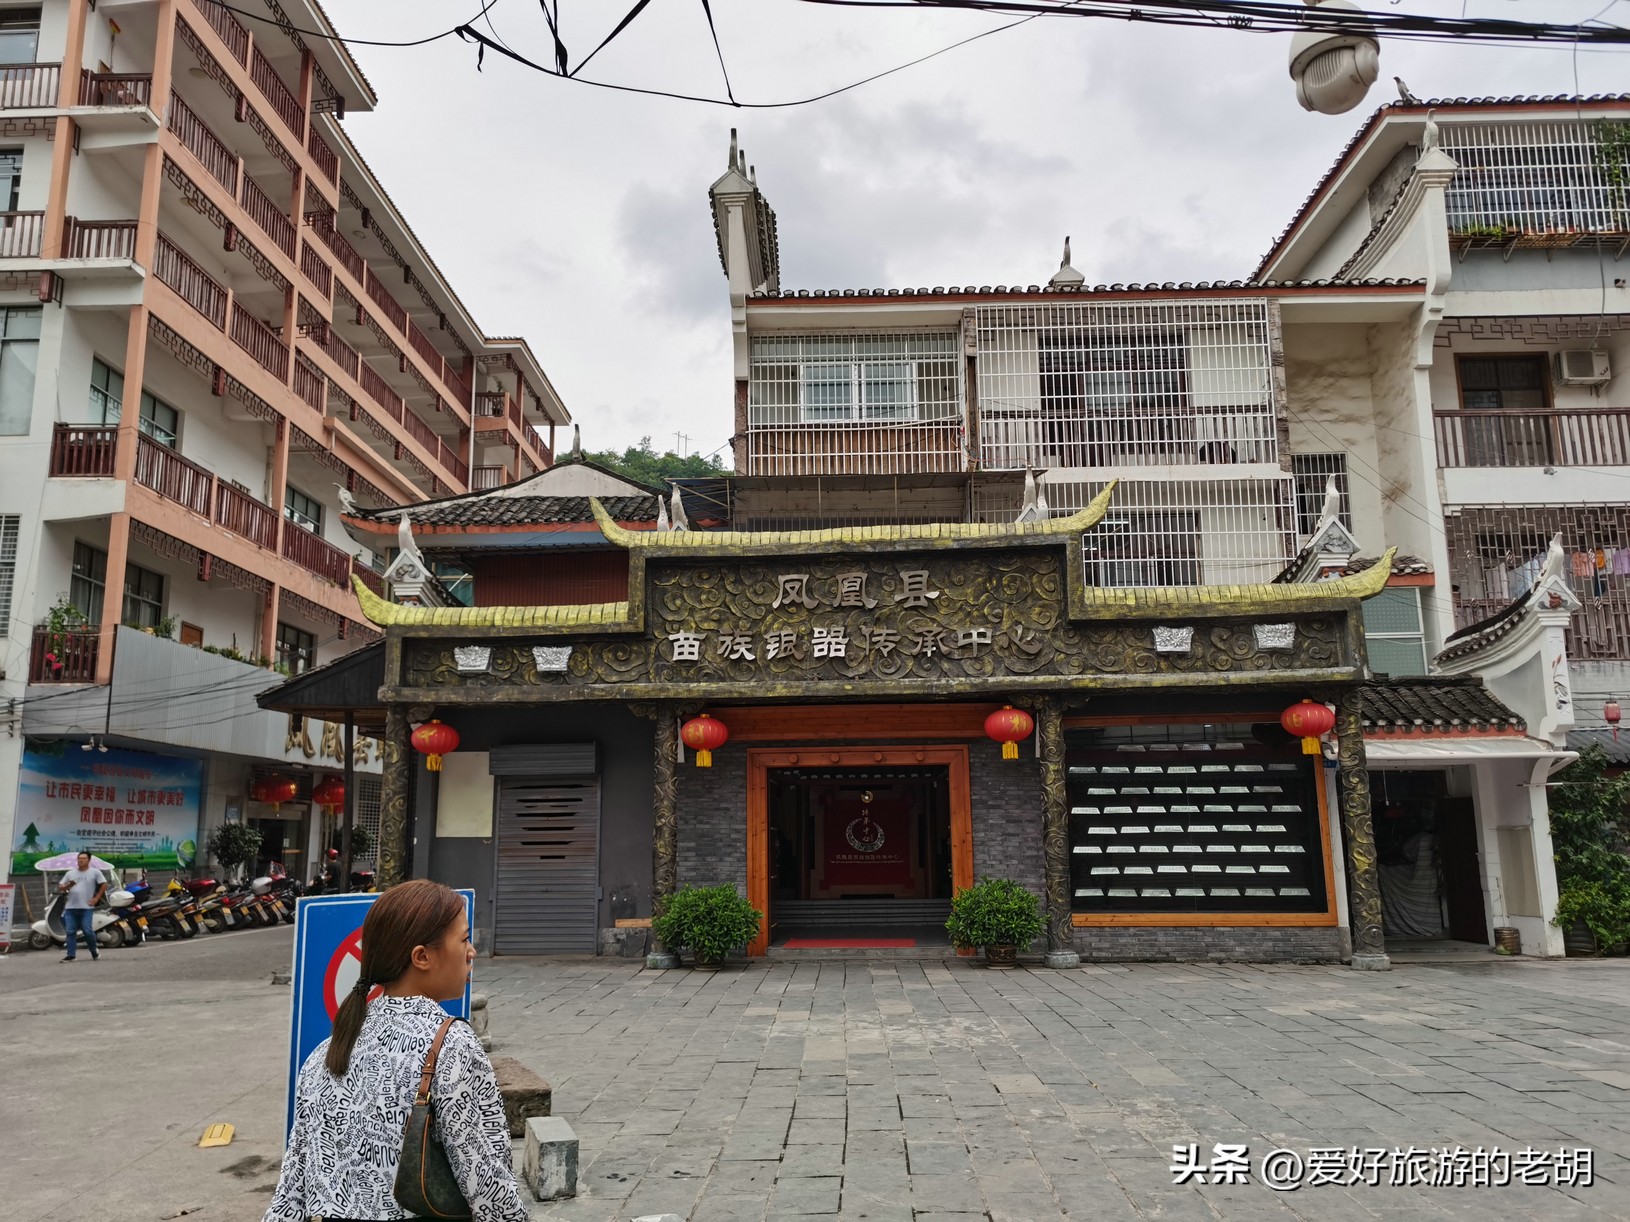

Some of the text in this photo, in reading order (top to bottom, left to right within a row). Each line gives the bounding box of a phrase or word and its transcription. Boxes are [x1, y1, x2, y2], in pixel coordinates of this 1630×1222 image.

[774, 570, 940, 609] 凤凰县
[669, 624, 1042, 662] 苗族银器传承中心
[46, 781, 184, 806] 让市民更幸福 让城市更美好
[80, 806, 155, 826] 凤凰因你而文明
